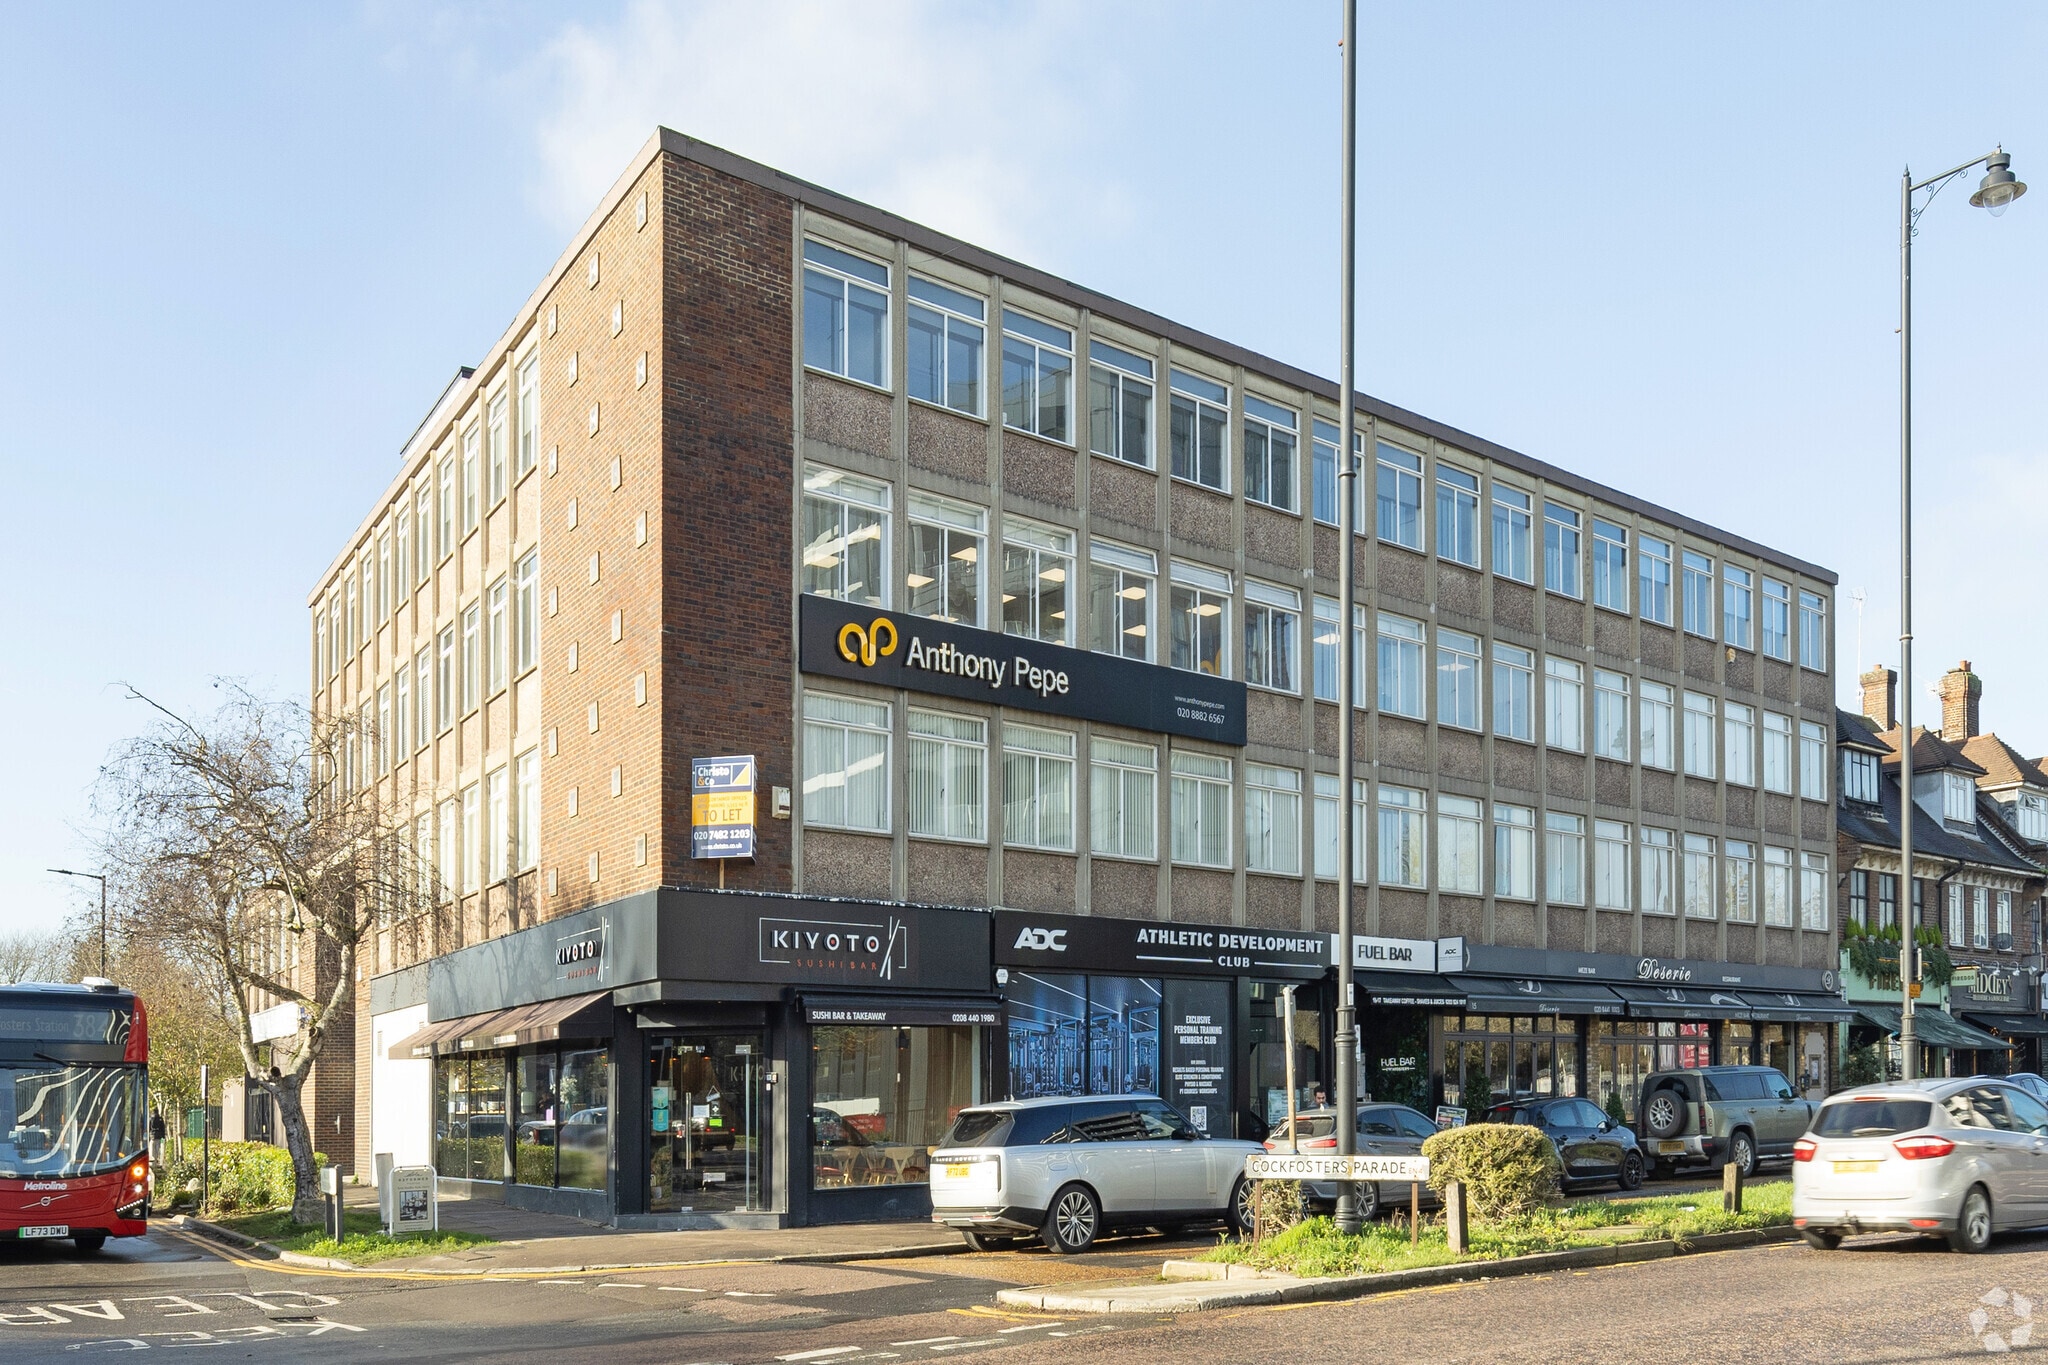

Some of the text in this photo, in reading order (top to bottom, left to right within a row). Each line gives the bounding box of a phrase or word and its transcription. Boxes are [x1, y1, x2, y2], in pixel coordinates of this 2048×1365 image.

[906, 636, 1069, 697] Anthony Pepe
[1177, 707, 1225, 724] 020 8882 6567
[697, 766, 730, 776] Christo
[702, 808, 742, 822] TO LET
[693, 831, 708, 840] 020
[730, 829, 750, 839] 1203
[772, 930, 880, 953] KIYOTO
[1013, 927, 1067, 951] ADC
[1136, 928, 1323, 954] ATHLETIC DEVELOPMENT
[555, 940, 597, 965] KIYOTO
[1358, 944, 1412, 961] FUEL BAR
[797, 958, 877, 971] SUSHI BAR
[1217, 955, 1250, 968] CLUB
[1637, 958, 1691, 981] Deserie
[812, 1010, 887, 1021] SUSHI BAR & TAKEAWAY
[952, 1013, 995, 1022] 0208 440 1980
[1185, 1015, 1211, 1024] EXCLUSIVE
[0, 1016, 69, 1033] osters Station
[1173, 1025, 1222, 1035] PERSONAL TRAINING
[1180, 1036, 1217, 1044] MEMBERS CLUB
[1380, 1056, 1416, 1067] FUEL BAR
[1252, 1160, 1348, 1174] COCKFOSTERS
[1354, 1161, 1406, 1174] PARADE
[24, 1181, 68, 1191] Metroline
[25, 1227, 48, 1237] LF73
